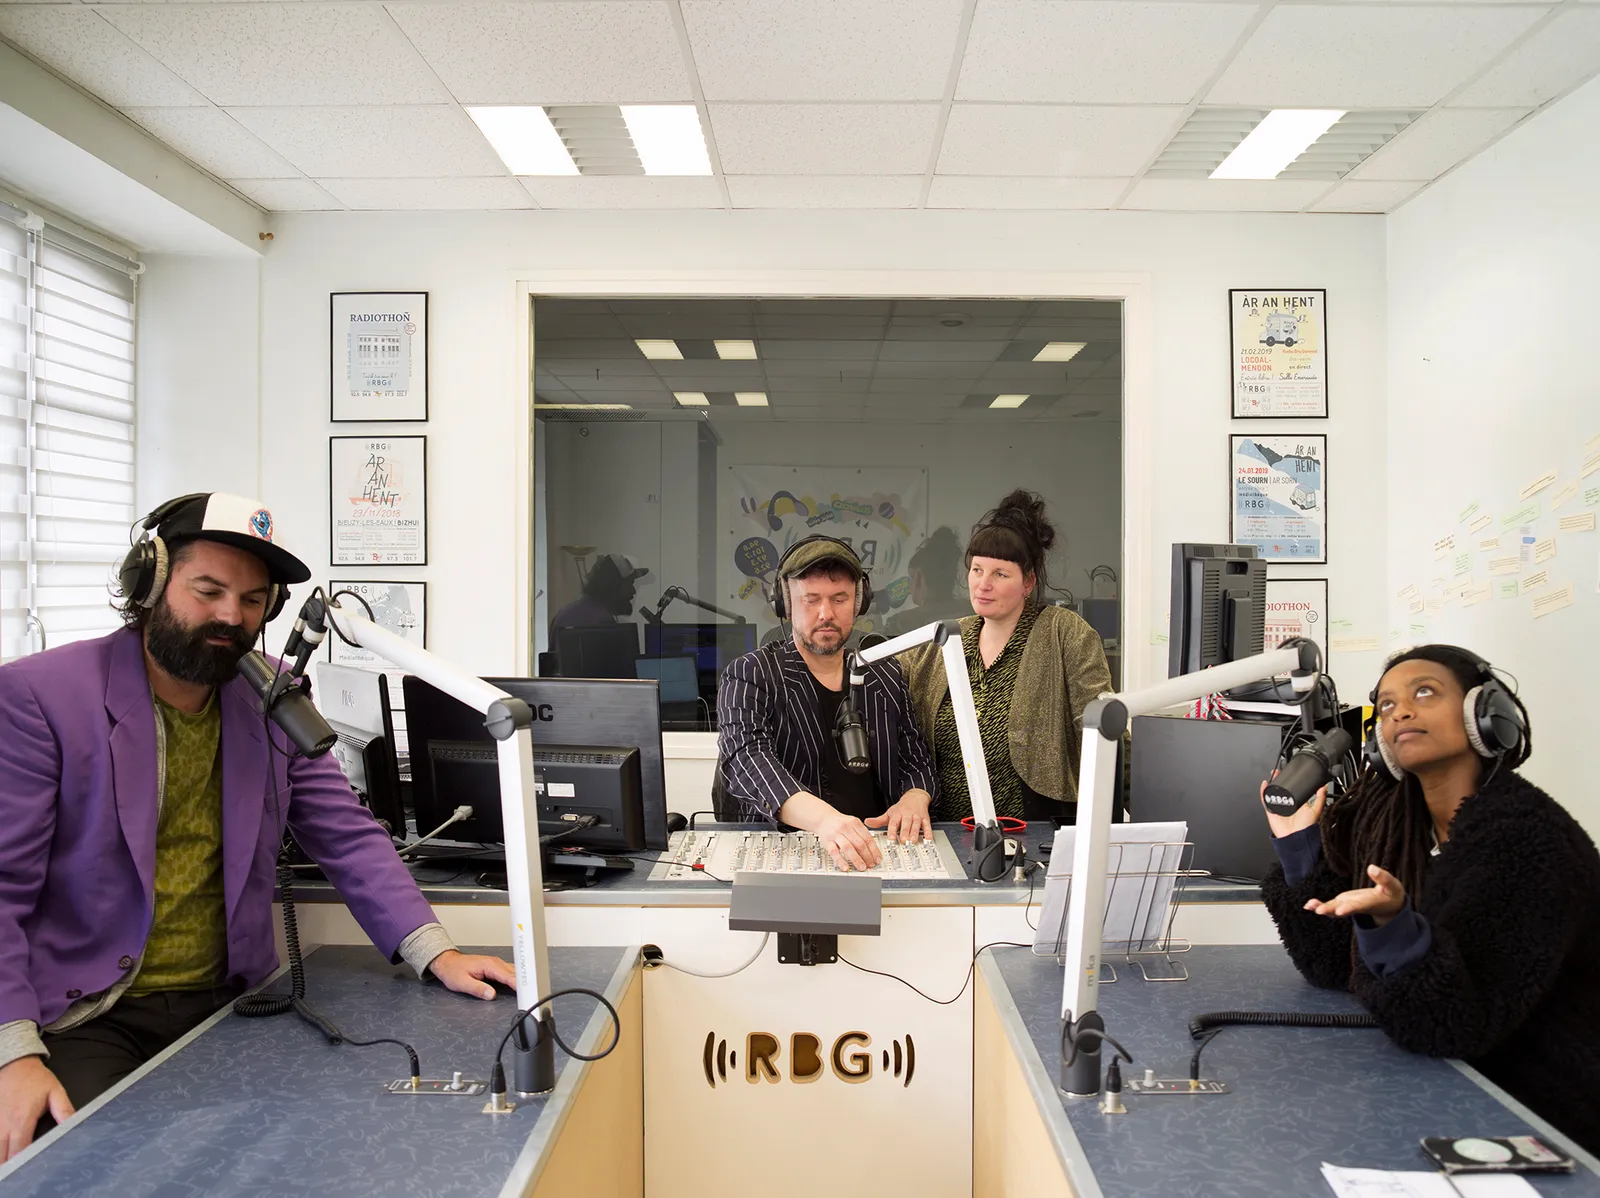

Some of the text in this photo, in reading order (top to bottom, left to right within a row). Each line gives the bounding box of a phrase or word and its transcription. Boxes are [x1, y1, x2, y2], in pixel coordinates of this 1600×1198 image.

[1242, 294, 1315, 308] ÀR AN HENT
[1241, 356, 1272, 364] LOCOAL-
[1248, 385, 1265, 393] RBG
[1307, 446, 1316, 455] AN
[367, 471, 389, 489] AN
[1247, 476, 1268, 484] SOURN
[363, 485, 399, 508] HENT
[1245, 500, 1264, 508] RBG
[352, 507, 401, 518] 29/11/2018
[1265, 602, 1311, 611] DIOTHON
[746, 1031, 873, 1085] RBG
